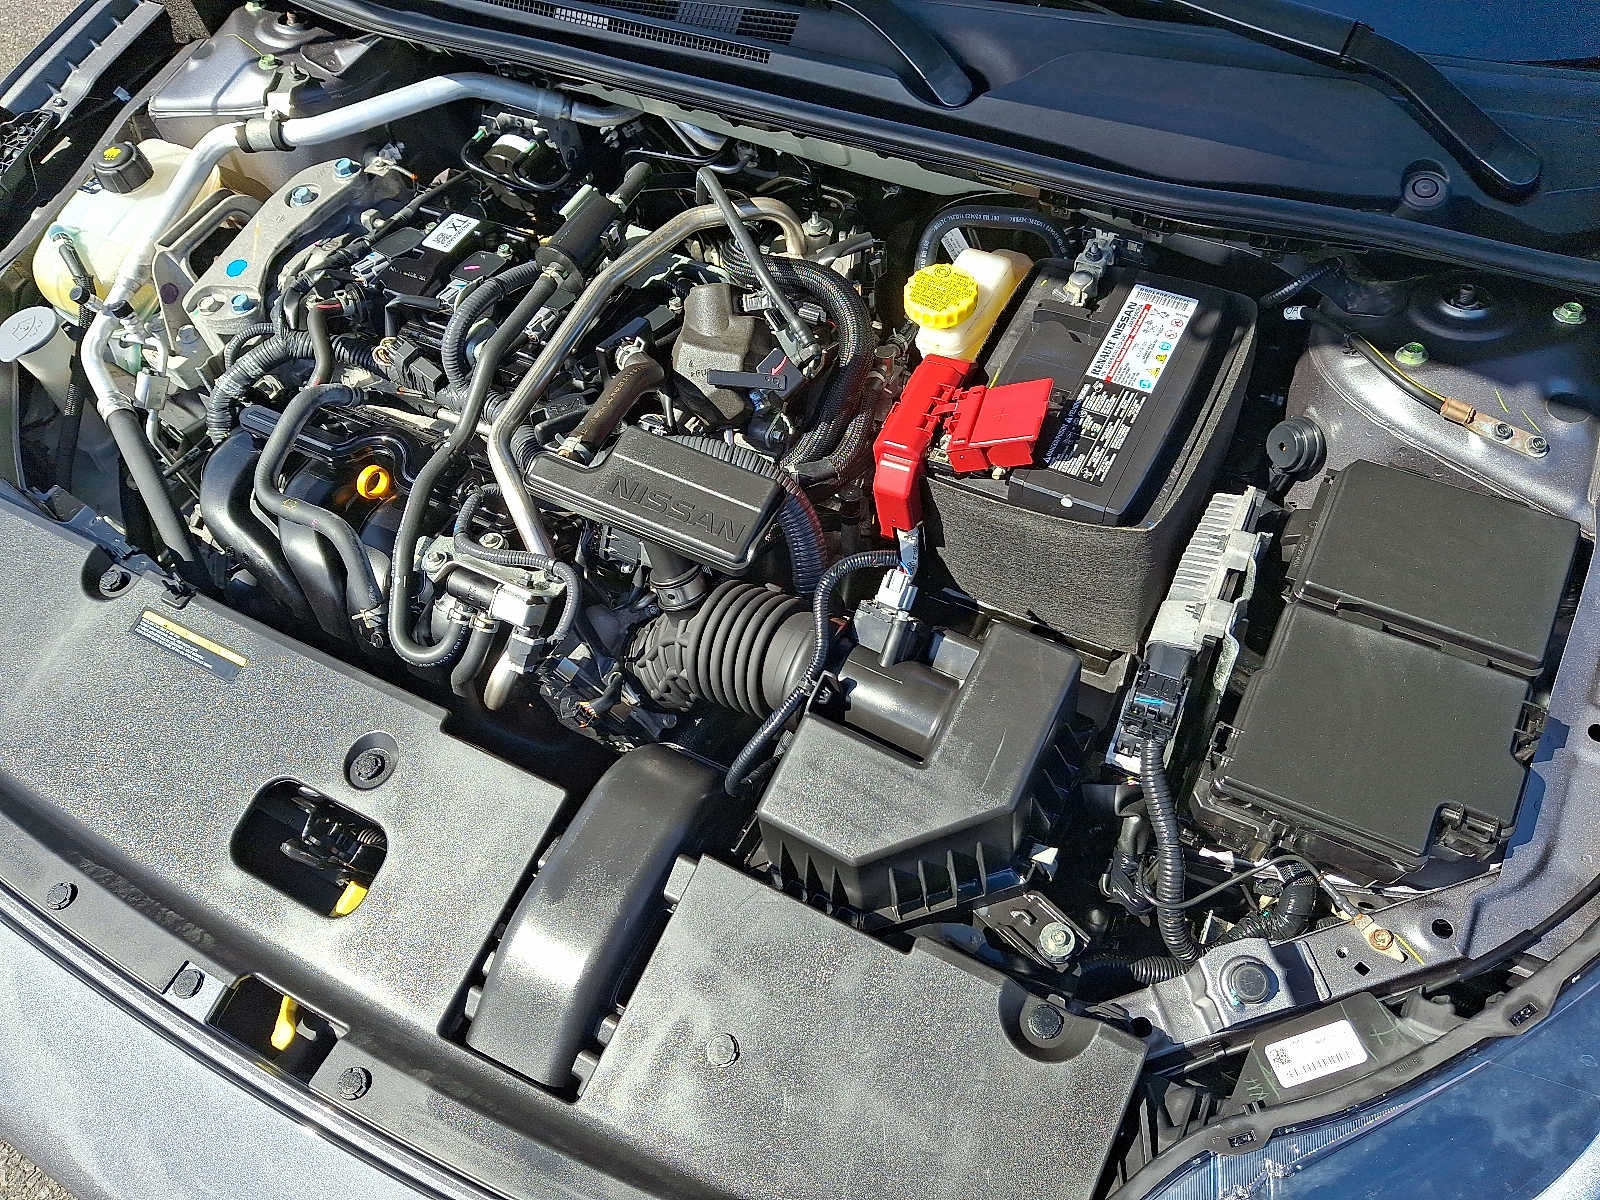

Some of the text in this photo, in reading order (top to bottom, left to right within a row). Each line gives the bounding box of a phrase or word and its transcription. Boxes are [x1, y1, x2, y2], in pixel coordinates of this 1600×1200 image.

[446, 218, 469, 232] TX
[1091, 341, 1118, 376] RENAULT
[1112, 301, 1138, 340] NISSAN
[607, 474, 746, 544] NISSAN
